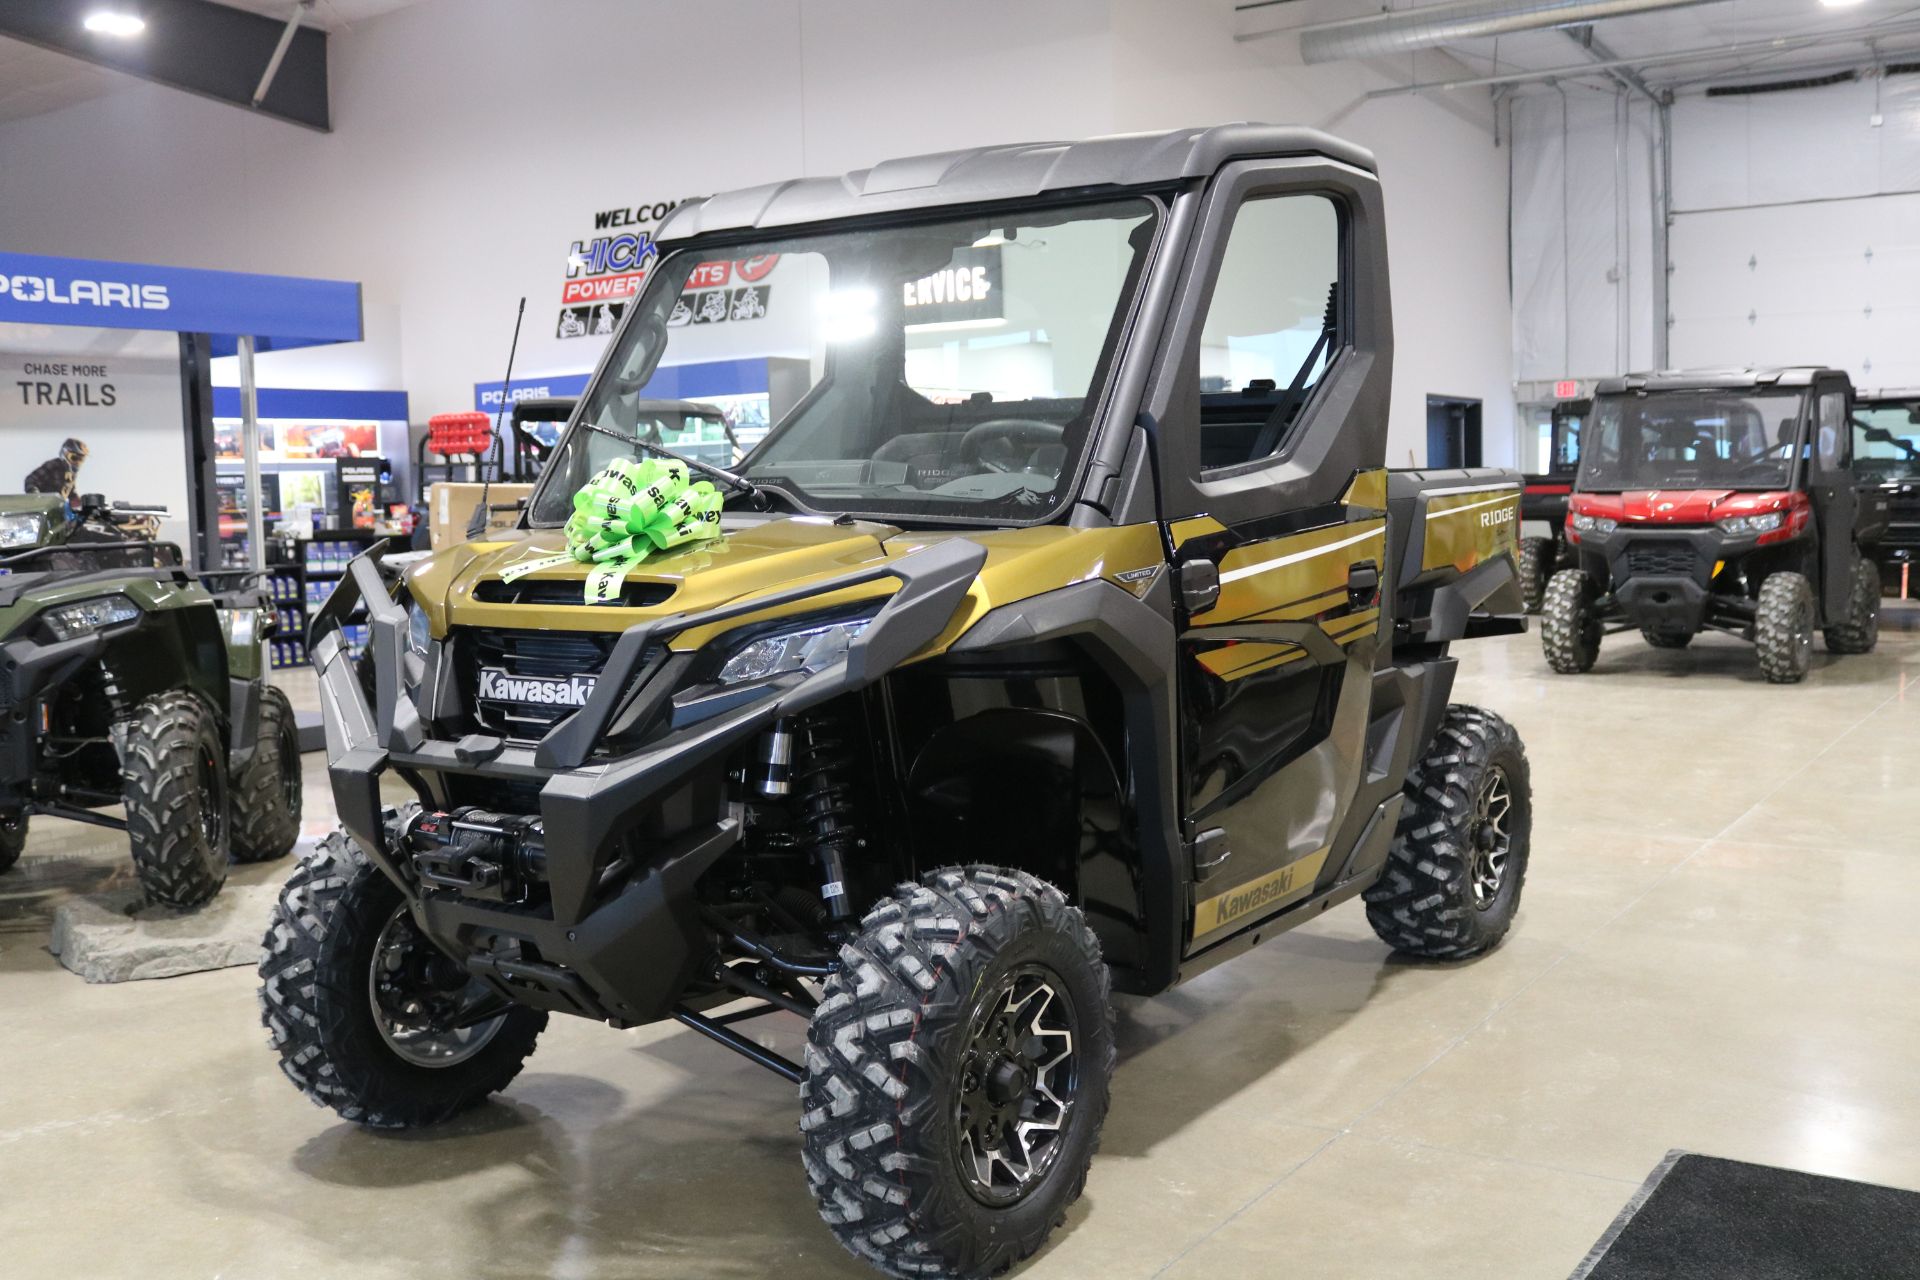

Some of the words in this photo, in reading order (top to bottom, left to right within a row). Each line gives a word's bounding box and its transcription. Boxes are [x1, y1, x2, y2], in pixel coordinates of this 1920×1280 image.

[595, 199, 686, 230] WELCO
[903, 266, 986, 306] ERVICE
[23, 363, 69, 376] CHASE
[72, 365, 108, 377] MORE
[16, 381, 117, 407] TRAILS
[481, 386, 550, 405] POLARIS
[1557, 381, 1576, 397] EXIT
[1480, 506, 1514, 528] RIDGE
[1126, 569, 1152, 580] LIMITED
[478, 670, 597, 706] Kawasaki
[1215, 866, 1294, 924] Kawasaki
